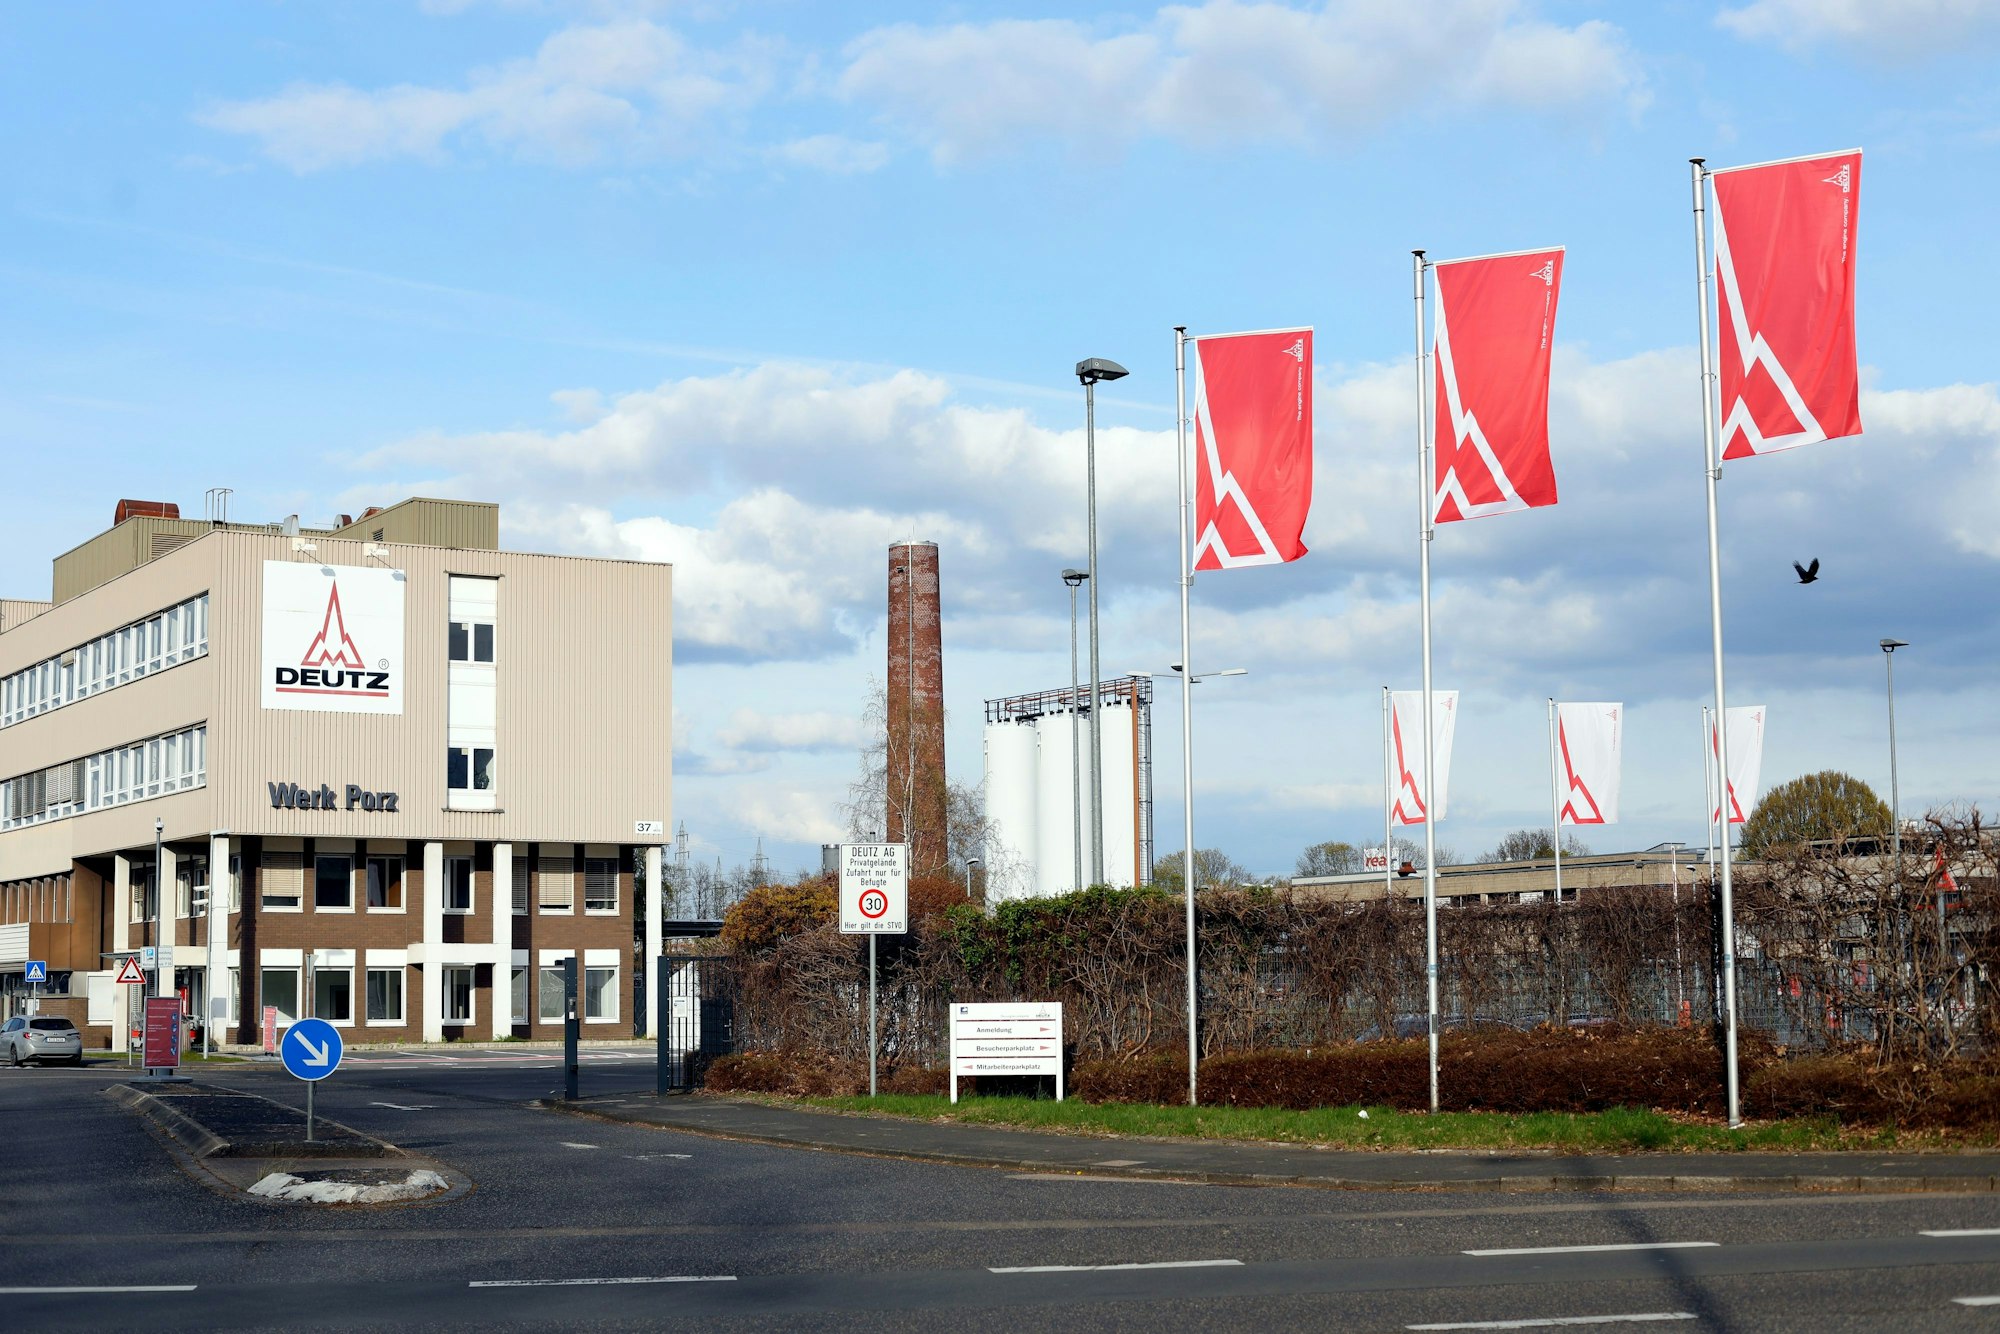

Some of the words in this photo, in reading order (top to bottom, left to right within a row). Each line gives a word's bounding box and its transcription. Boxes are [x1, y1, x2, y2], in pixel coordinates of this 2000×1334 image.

[276, 667, 389, 690] DEUTZ
[268, 782, 337, 811] Werk
[346, 784, 399, 812] Porz
[638, 823, 651, 831] 37
[852, 846, 878, 857] DEUTZ
[884, 847, 895, 857] AG
[850, 858, 897, 868] Privatgelände
[846, 868, 871, 877] Zufahrt
[891, 868, 901, 877] für
[860, 878, 887, 887] Befugte
[865, 898, 882, 910] 30
[861, 922, 871, 930] gilt
